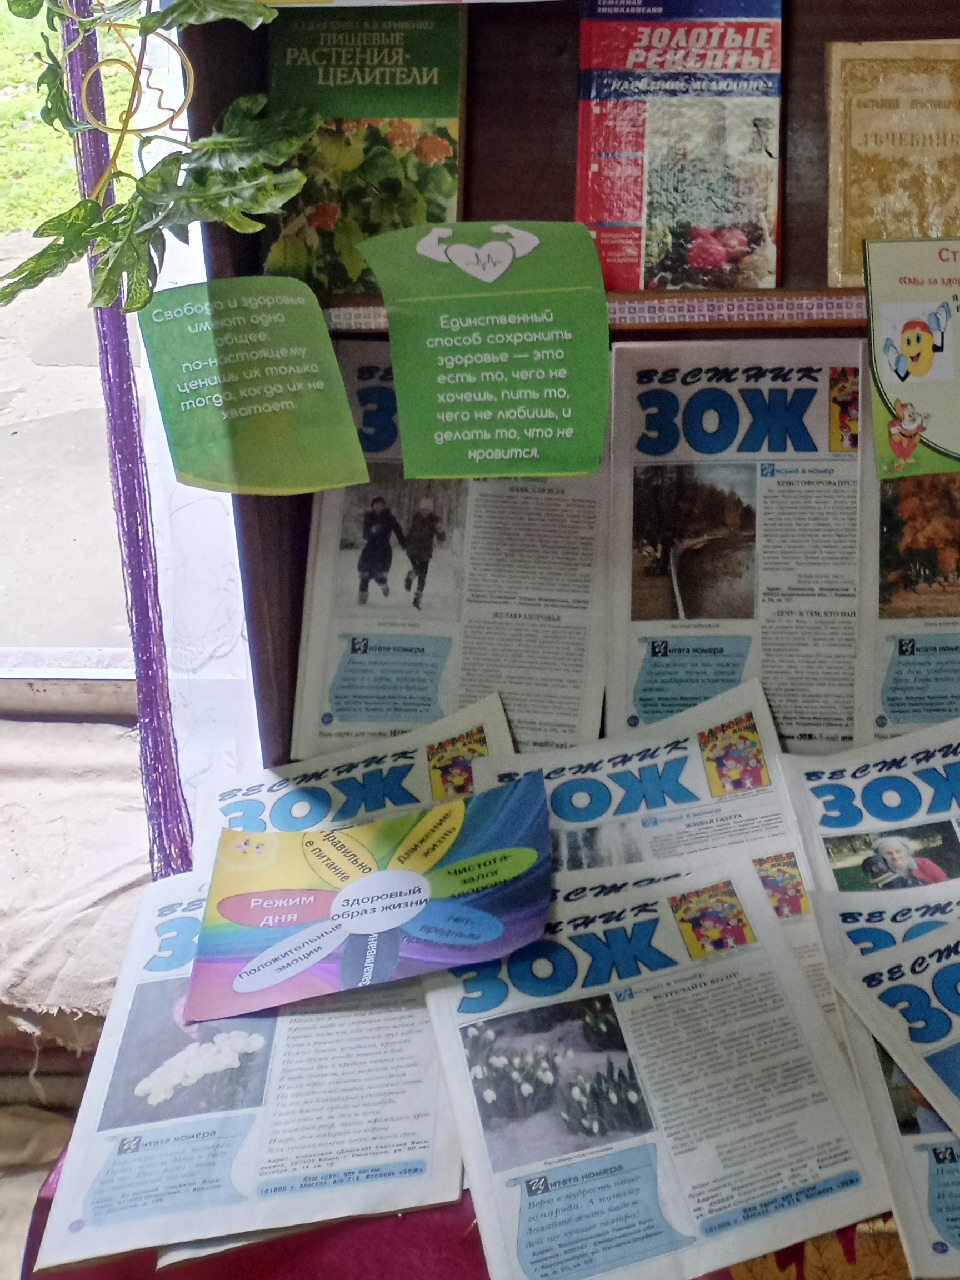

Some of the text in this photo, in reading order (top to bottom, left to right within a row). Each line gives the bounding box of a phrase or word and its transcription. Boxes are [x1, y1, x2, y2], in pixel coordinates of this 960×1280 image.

[320, 32, 405, 48] ПИЩЕВЫЕ
[633, 27, 773, 48] ЗОЛОТЫЕ
[285, 47, 412, 66] РАСТЕНИЯ-
[626, 49, 772, 70] РЕЦЕПТЫ
[317, 67, 439, 88] ЦЕЛИТЕЛИ
[151, 295, 305, 323] Свобода здоровье
[188, 312, 286, 334] имеют одно
[440, 309, 554, 332] Единственный
[426, 329, 572, 348] способ сохранить
[181, 347, 307, 373] по-настоящему
[437, 349, 565, 369] здоровье это
[437, 369, 545, 385] есть чего
[635, 366, 823, 386] ВЕСТНИК
[635, 387, 819, 457] ЗОЖ
[434, 429, 492, 445] делать
[218, 748, 418, 804] ВЕСТНИК
[219, 762, 426, 834] ЗОЖ
[549, 756, 704, 824] ОЖ
[250, 894, 315, 909] Режим
[341, 886, 423, 908] Здоровый
[260, 912, 298, 928] дня
[331, 898, 430, 921] образ жизни
[275, 945, 324, 974] эмоции
[456, 928, 678, 1015] ЗОЖ
